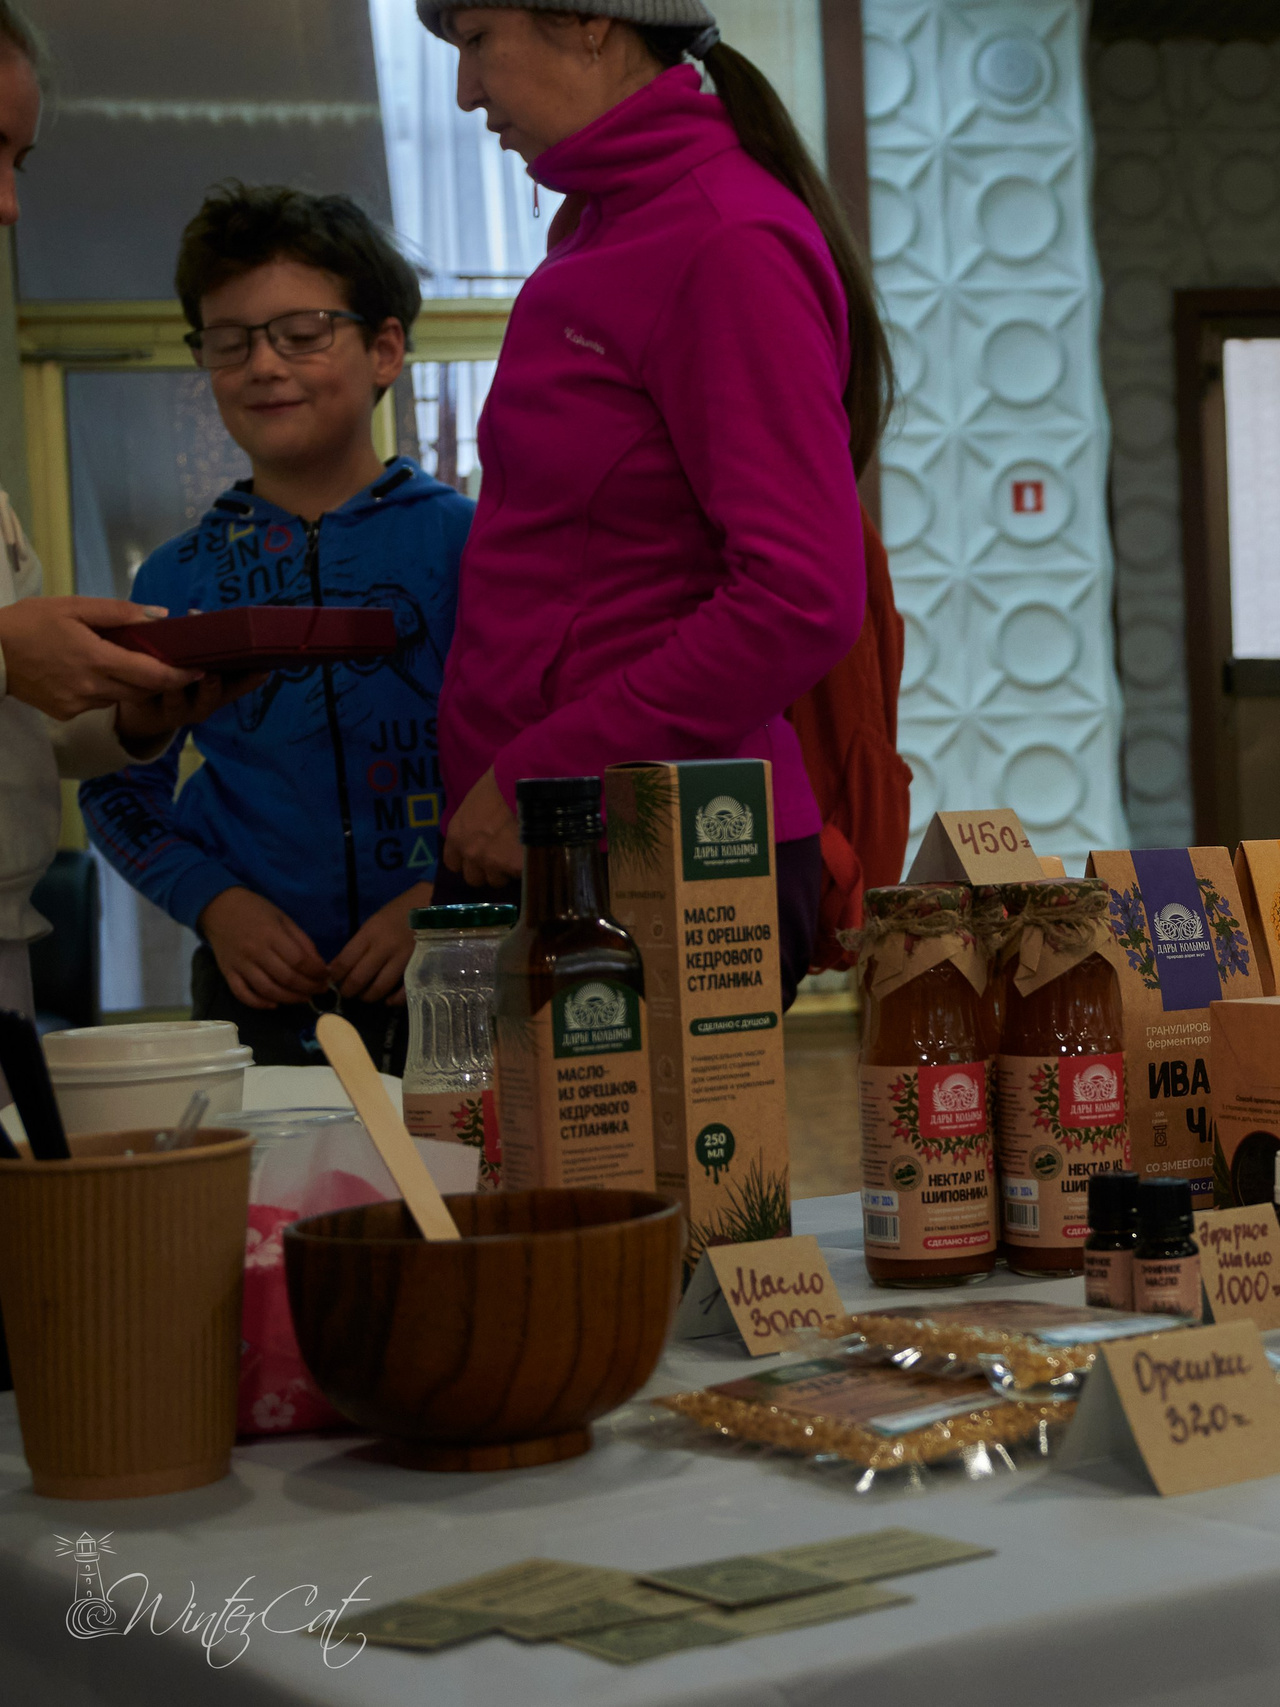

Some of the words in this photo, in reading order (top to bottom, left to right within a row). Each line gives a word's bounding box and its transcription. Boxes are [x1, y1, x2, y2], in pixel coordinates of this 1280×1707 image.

[370, 718, 439, 753] JUS
[692, 846, 720, 861] ДАРЫ
[684, 906, 736, 925] МАСЛО
[685, 929, 709, 947] ИЗ
[707, 924, 772, 944] ОРЕШКОВ
[1157, 943, 1178, 954] ДАРЫ
[1180, 941, 1211, 953] КОЛЫМЫ
[686, 948, 763, 971] КЕДРОВОГО
[687, 970, 763, 993] СТЛАНИКА
[697, 1019, 734, 1034] СДЕЛАНО
[734, 1019, 742, 1030] С
[740, 1014, 772, 1029] ДУШОЙ
[1148, 1058, 1211, 1100] ИВА
[558, 1087, 575, 1101] ИЗ
[578, 1080, 638, 1099] ОРЕШКОВ
[559, 1100, 630, 1121] КЕДРОВОГО
[561, 1119, 631, 1140] СТЛАНИКА
[704, 1132, 728, 1148] 250
[1068, 1161, 1112, 1177] НЕКТАР
[1145, 1161, 1161, 1174] СО
[1162, 1156, 1214, 1171] ЗМЕЕГОЛО
[928, 1172, 973, 1187] НЕКТАР
[974, 1168, 986, 1182] ИЗ
[921, 1185, 989, 1205] ШИПОВНИКА
[1066, 1227, 1093, 1236] СДЕЛА
[927, 1238, 963, 1249] СДЕЛАНО
[730, 1266, 824, 1307] Масло
[1145, 1276, 1179, 1287] МАСЛО
[1133, 1350, 1253, 1402] Орешки
